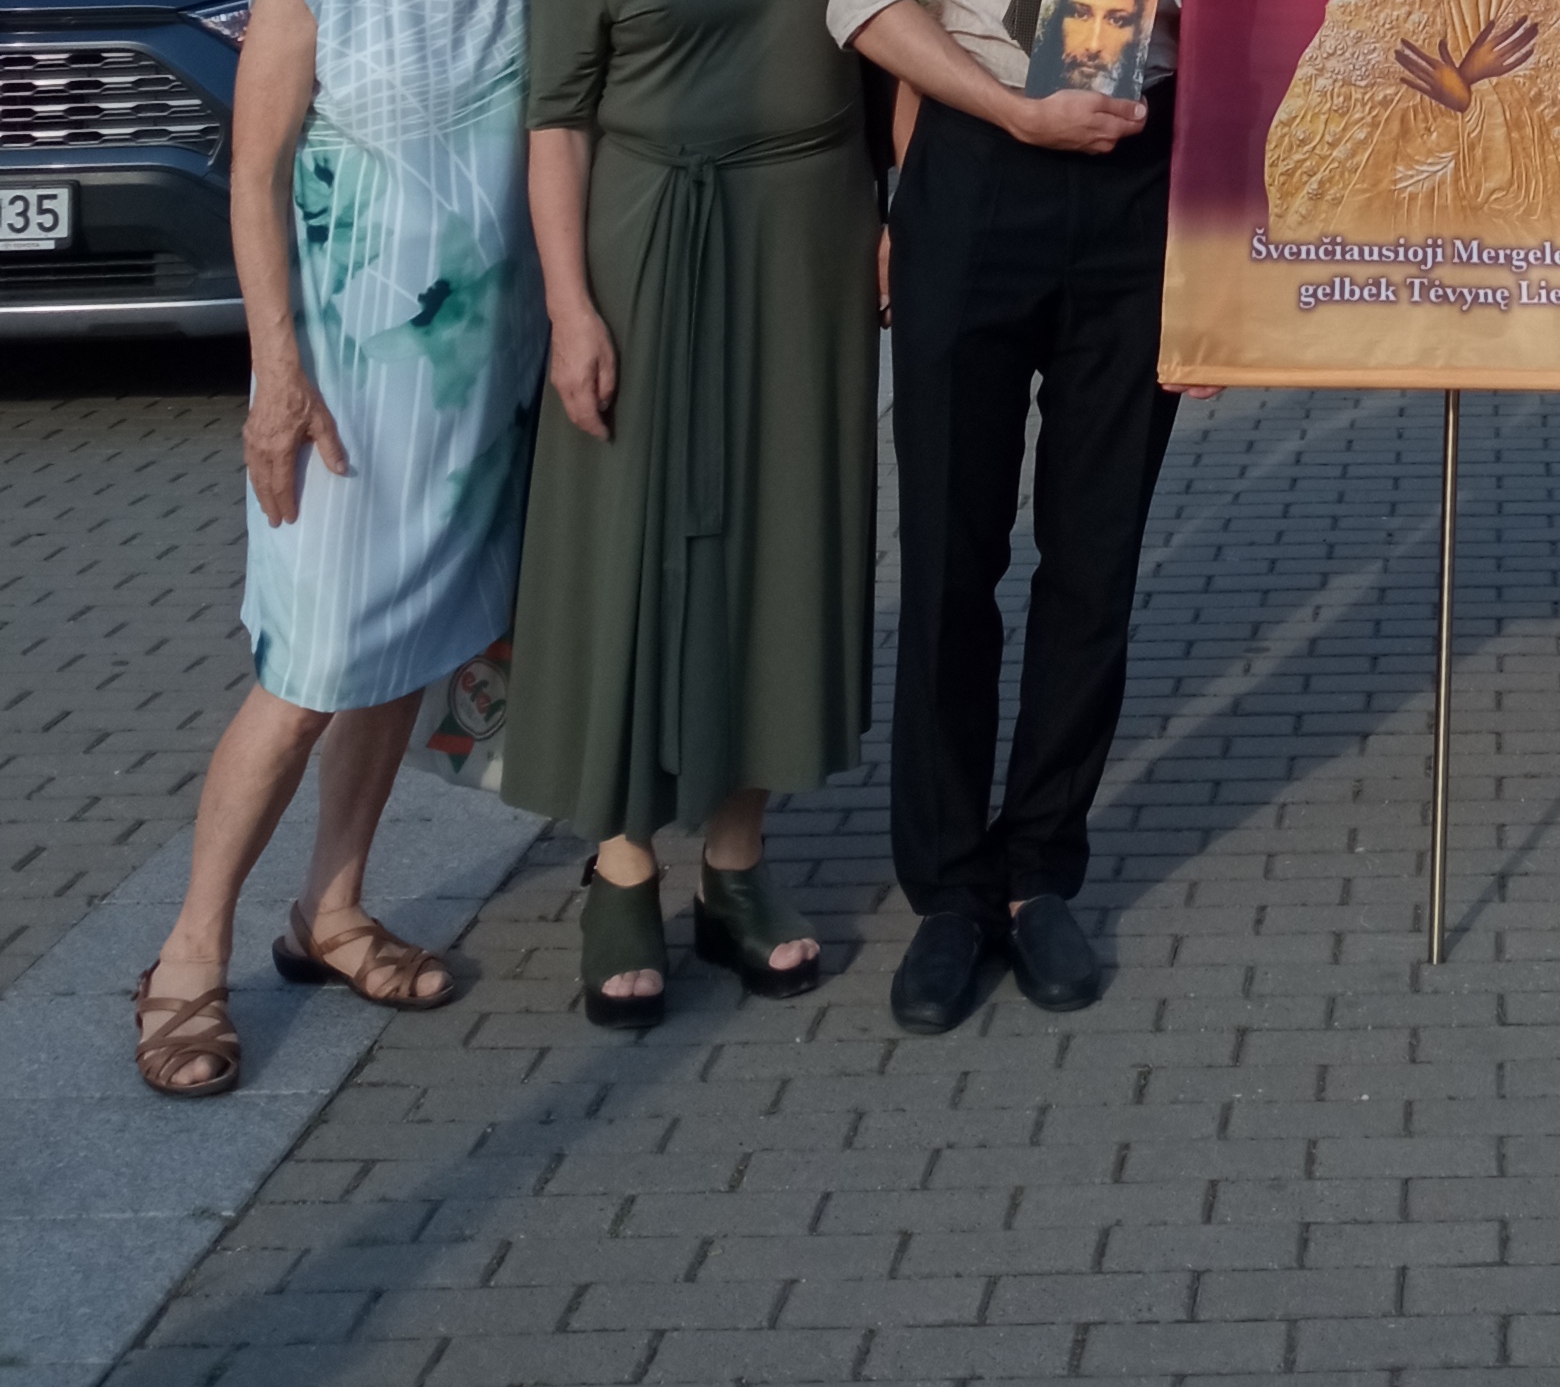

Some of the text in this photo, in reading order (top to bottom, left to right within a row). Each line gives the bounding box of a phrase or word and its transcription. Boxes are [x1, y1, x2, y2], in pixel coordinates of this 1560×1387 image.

[0, 194, 59, 234] 35
[1251, 228, 1444, 270] Švenčiausioji
[1299, 277, 1396, 308] gelbėk
[1406, 277, 1510, 311] Tėvynę
